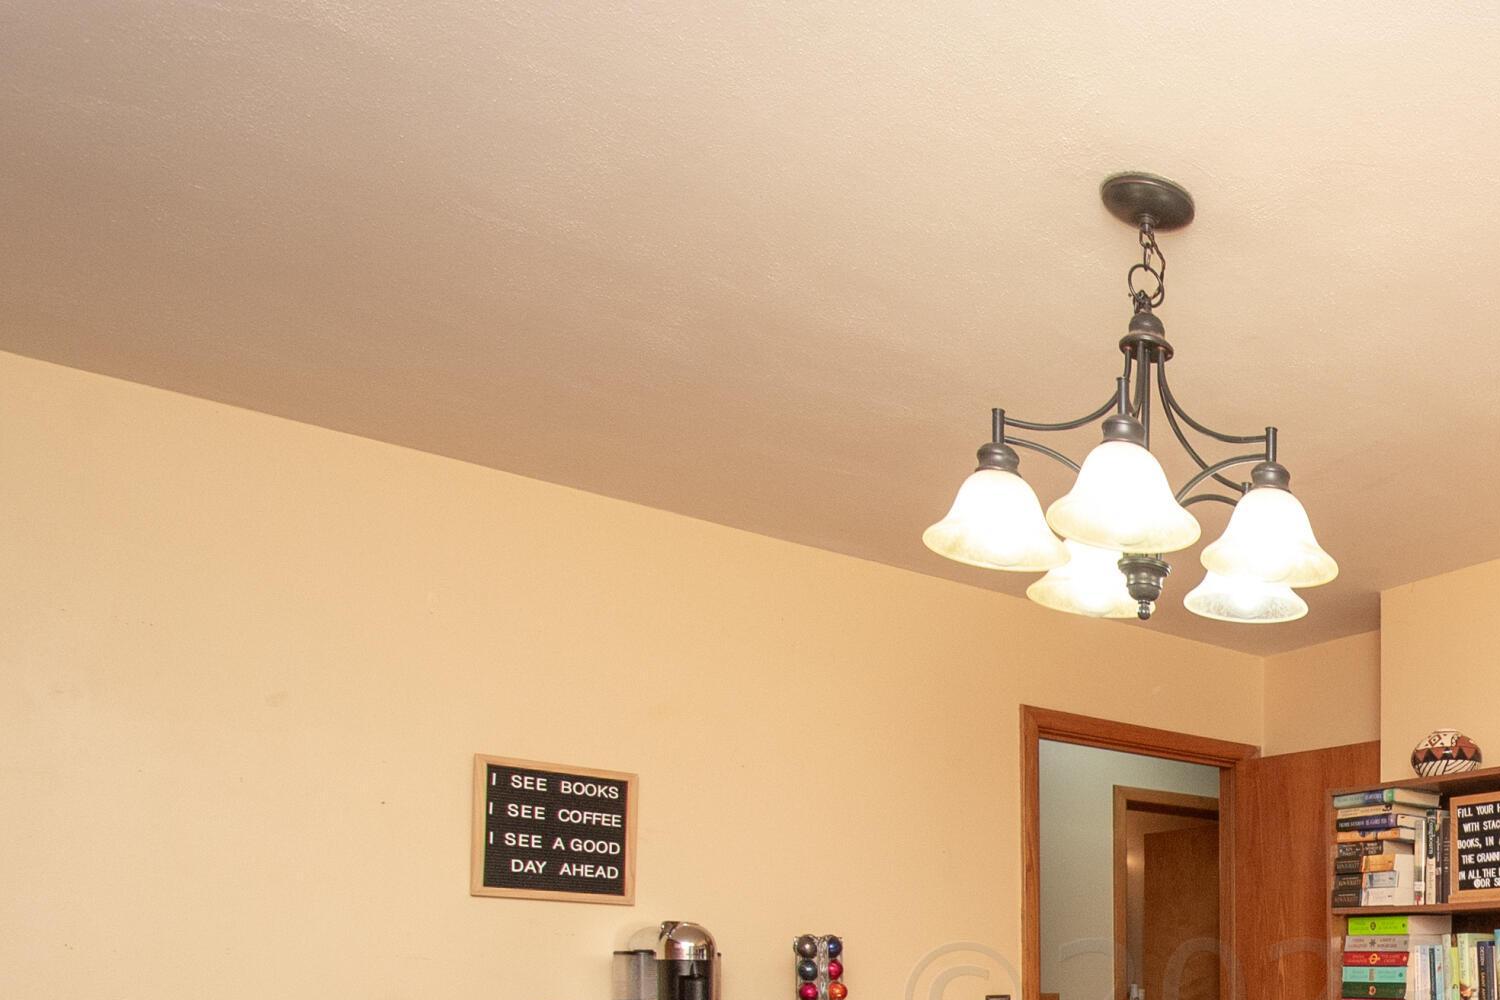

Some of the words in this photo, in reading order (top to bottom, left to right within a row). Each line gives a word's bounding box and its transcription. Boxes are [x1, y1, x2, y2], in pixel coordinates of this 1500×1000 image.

[491, 772, 497, 786] I
[510, 774, 548, 792] SEE
[560, 780, 619, 799] BOOKS
[488, 801, 494, 815] I
[507, 803, 546, 820] SEE
[558, 808, 622, 828] COFFEE
[1457, 807, 1473, 818] FILL
[1476, 804, 1494, 815] YOUR
[1462, 822, 1480, 833] WITH
[489, 831, 494, 845] I
[504, 832, 543, 849] SEE
[552, 837, 565, 851] A
[570, 838, 620, 855] GOOD
[1485, 835, 1494, 847] IN
[1461, 854, 1475, 865] THE
[511, 859, 547, 874] DAY
[560, 863, 619, 879] AHEAD
[1468, 869, 1481, 880] ALL
[1482, 867, 1496, 878] THE
